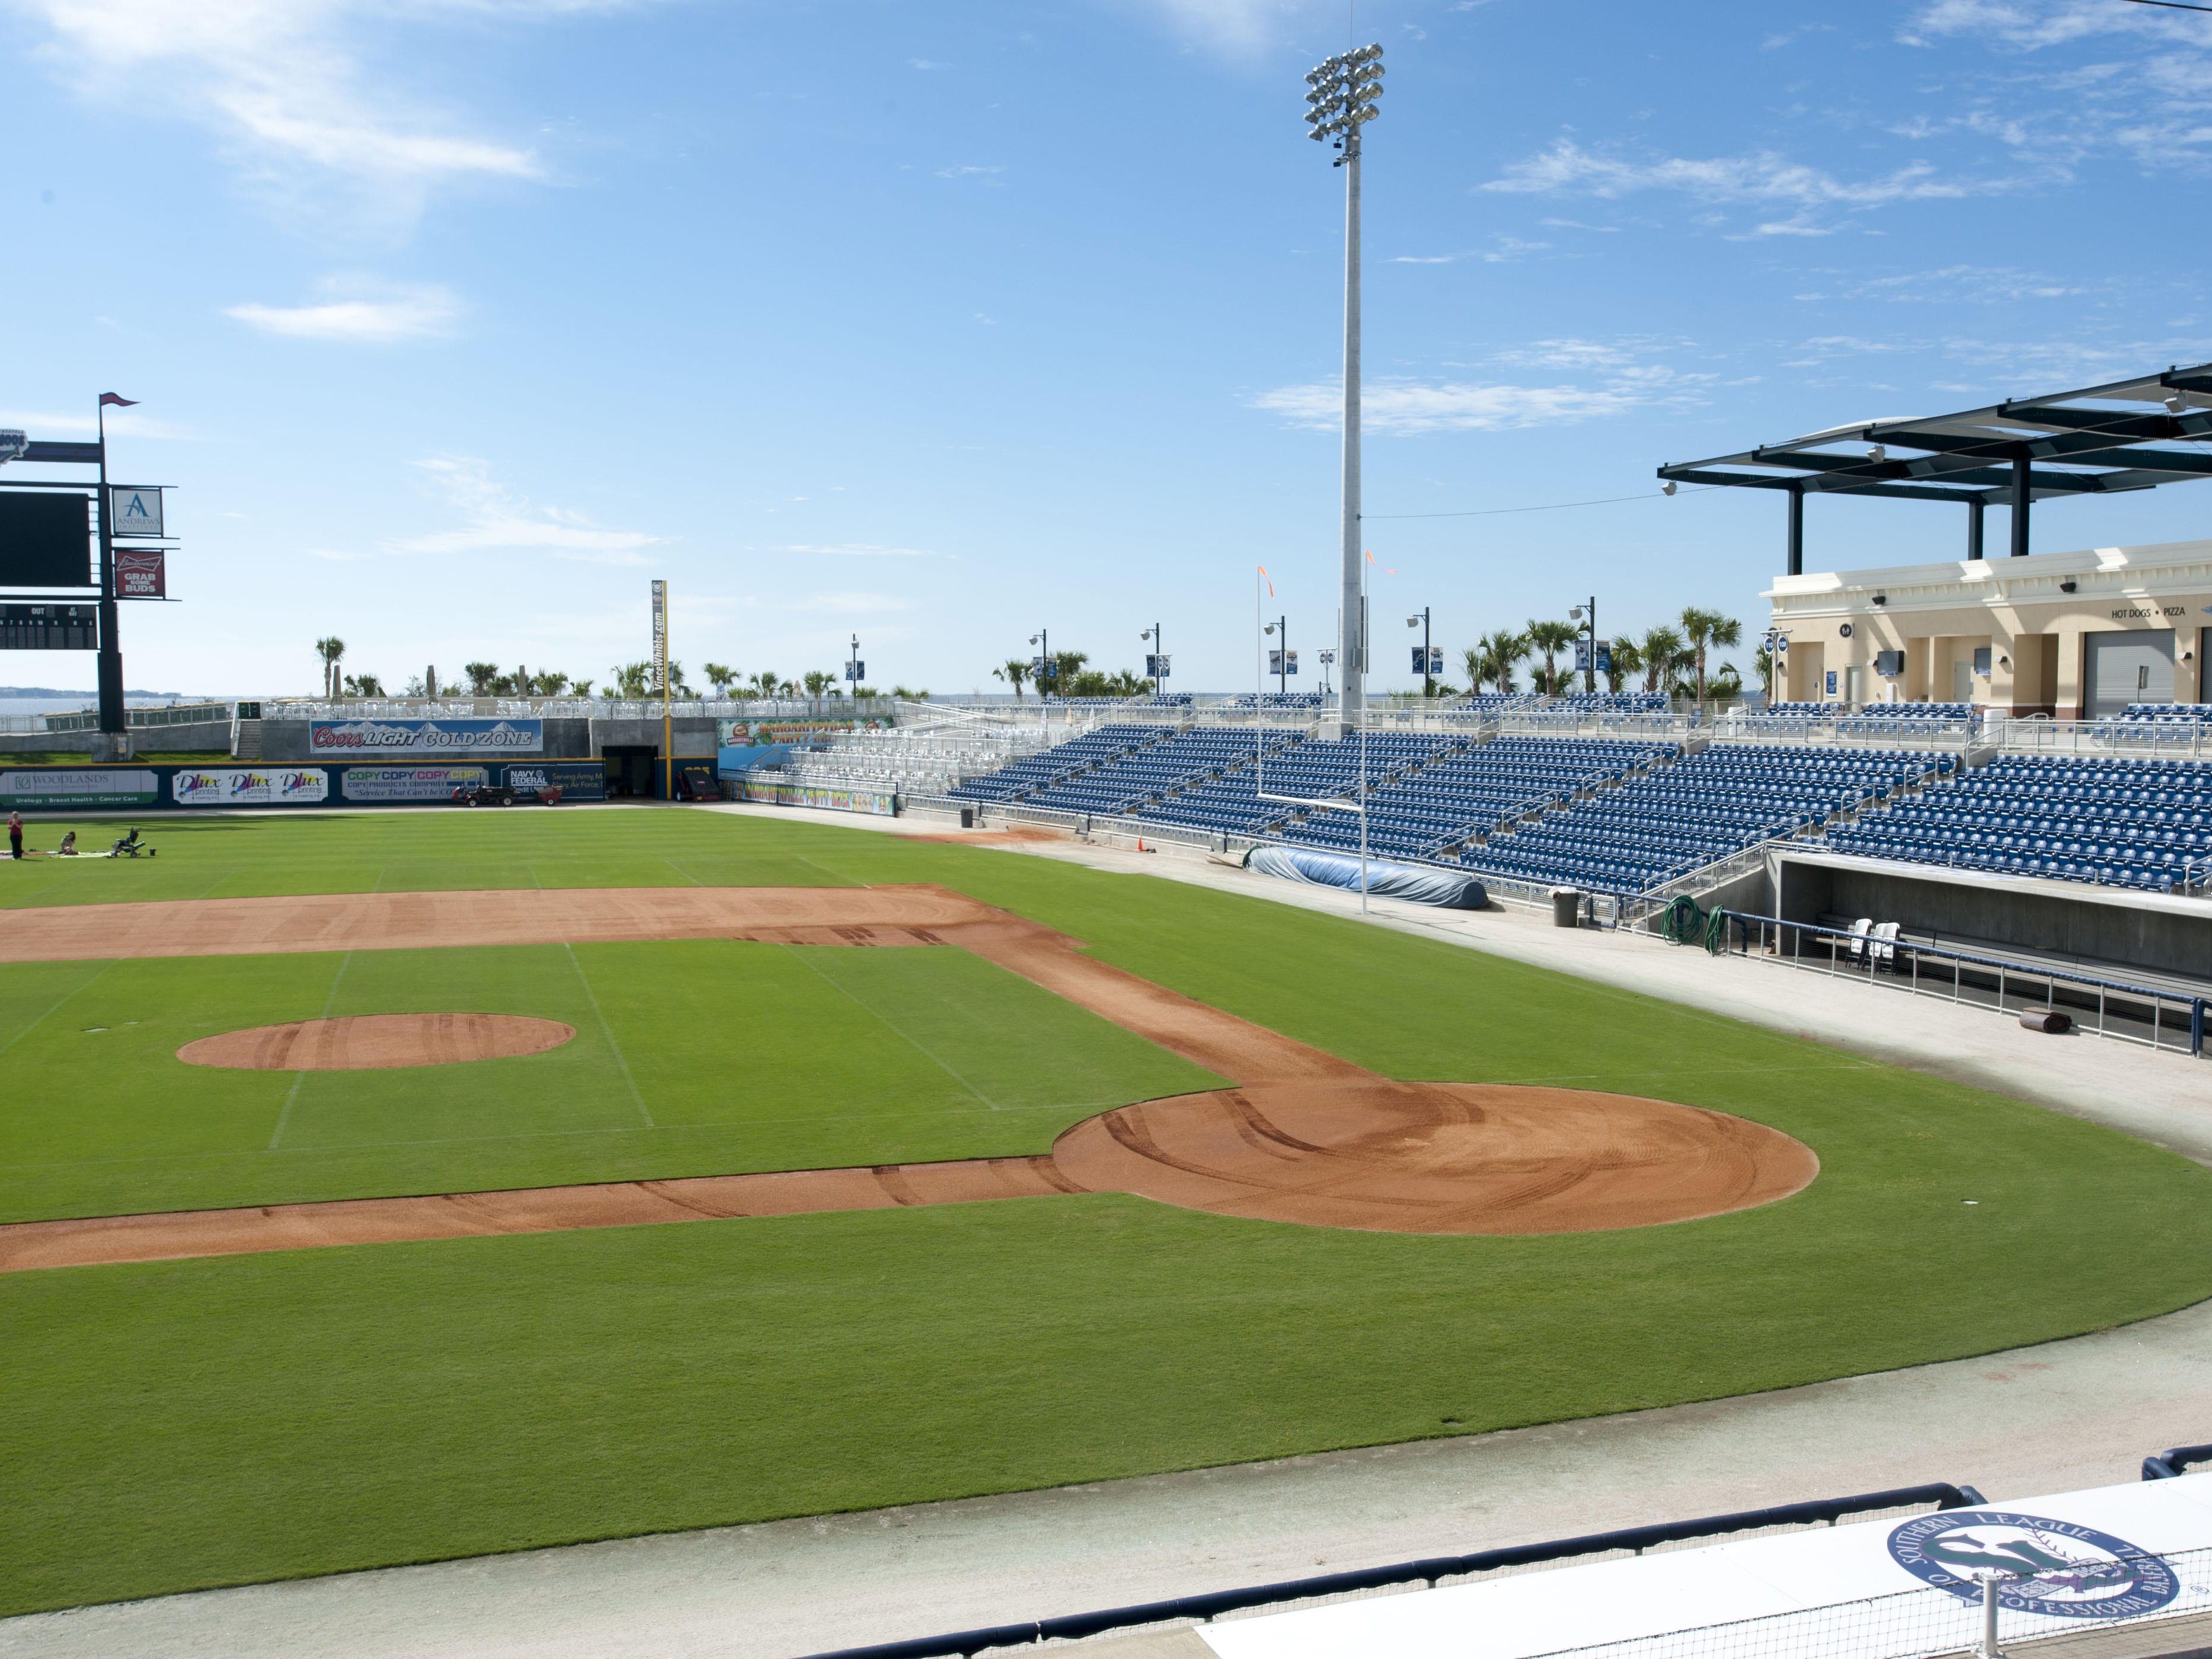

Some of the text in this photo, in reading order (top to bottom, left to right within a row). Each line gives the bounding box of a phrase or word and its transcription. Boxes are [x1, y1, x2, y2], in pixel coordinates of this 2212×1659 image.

[117, 517, 160, 525] ANDREWS
[2112, 606, 2186, 618] HOT DOGS PIZZA
[653, 612, 664, 691] VinceWhibbs.com
[313, 727, 533, 747] Coors LIGHT COLD ZONE
[33, 775, 109, 785] WOODLANDS
[177, 773, 223, 788] Dlux
[229, 772, 274, 788] Dlux
[280, 772, 325, 787] Dlux
[347, 771, 482, 780] COPY COPY COPY COPY
[552, 773, 576, 781] Serving
[577, 773, 594, 781] Army,
[195, 787, 219, 795] printing
[247, 787, 271, 795] printing
[806, 788, 829, 806] PARTY
[831, 791, 851, 808] DECK
[1895, 1513, 2097, 1564] SOUTHERN LEAGUE
[1971, 1588, 2158, 1616] OFESSIONAL
